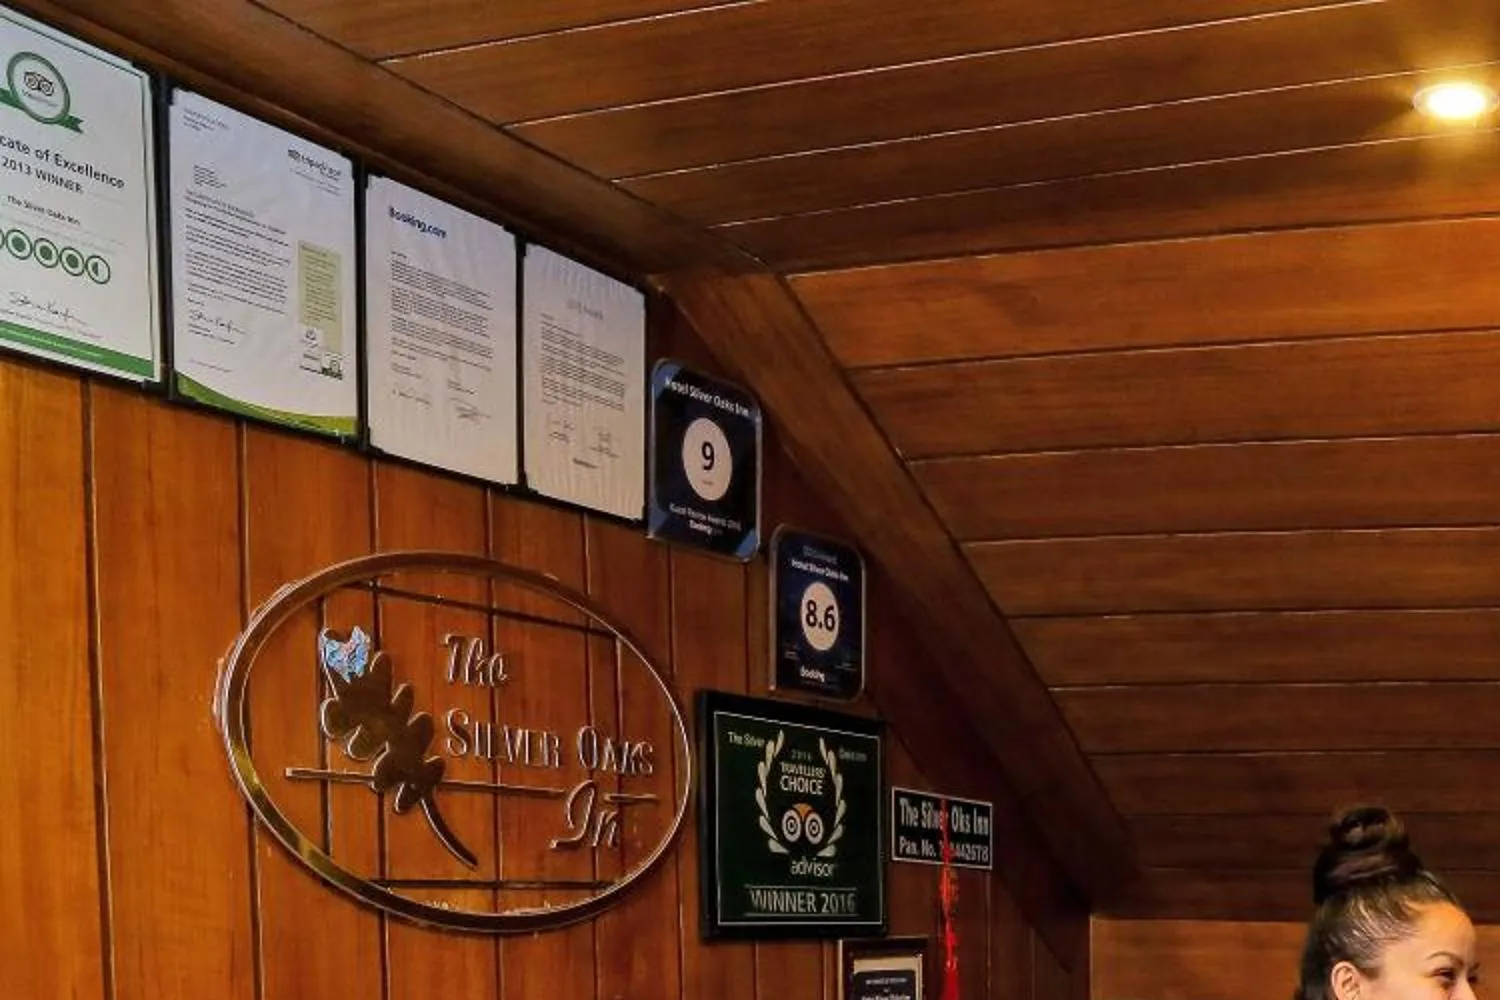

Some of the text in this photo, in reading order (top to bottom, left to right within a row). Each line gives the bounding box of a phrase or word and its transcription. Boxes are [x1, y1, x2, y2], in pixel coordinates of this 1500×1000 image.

[2, 155, 84, 194] 2013 WINNER
[35, 149, 50, 162] of
[54, 153, 125, 189] Excellence
[701, 441, 715, 471] 9
[805, 599, 836, 632] 8.6
[443, 633, 508, 687] The
[446, 707, 654, 776] SILVER OAKS
[727, 731, 765, 747] The Silver
[779, 774, 824, 795] CHOICE
[899, 796, 919, 828] The
[973, 806, 990, 836] Inn
[749, 888, 857, 914] WINNER 2016
